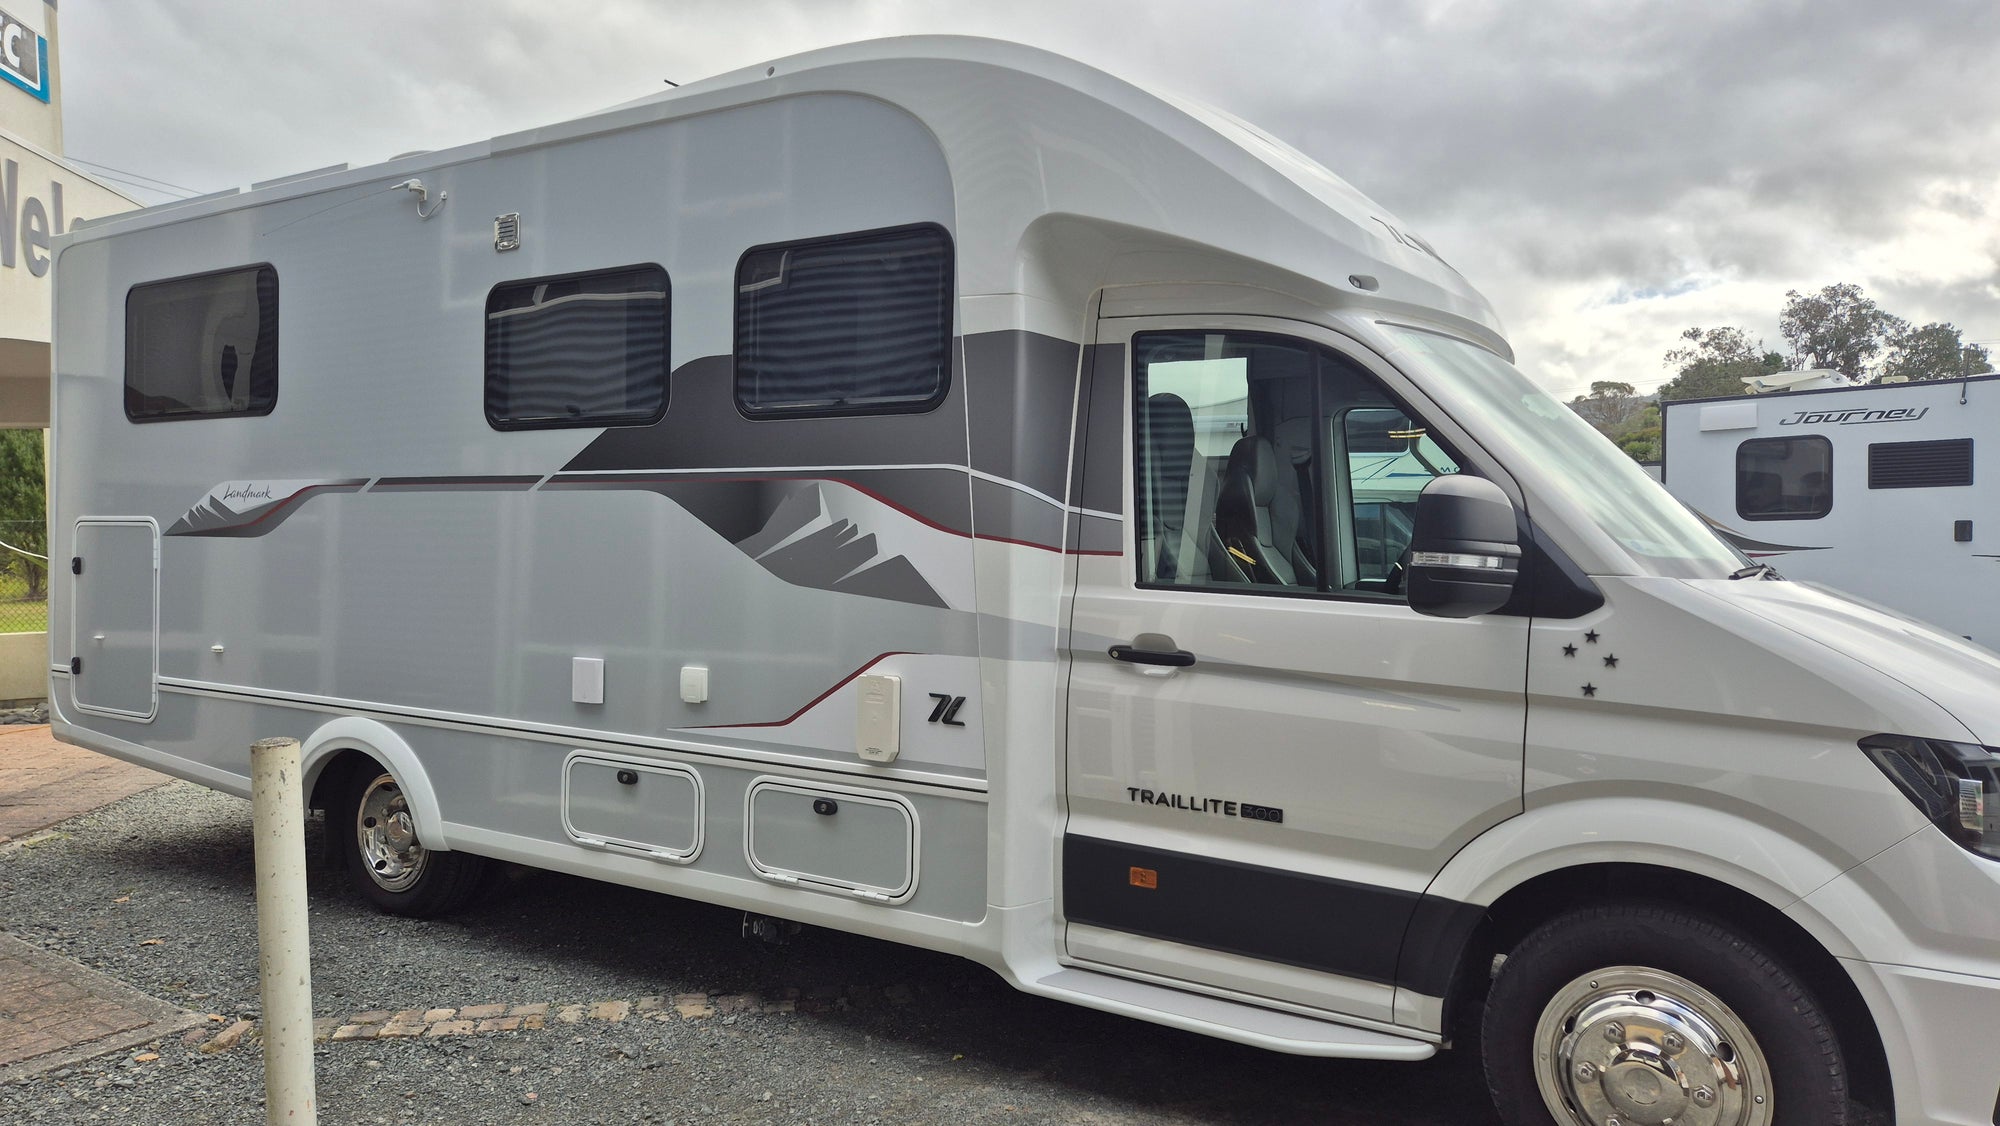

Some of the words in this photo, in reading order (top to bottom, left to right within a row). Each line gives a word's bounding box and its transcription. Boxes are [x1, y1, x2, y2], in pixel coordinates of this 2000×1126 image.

[1779, 407, 1929, 425] Journey
[223, 483, 272, 502] Landmark
[1127, 787, 1238, 816] TRAILLITE
